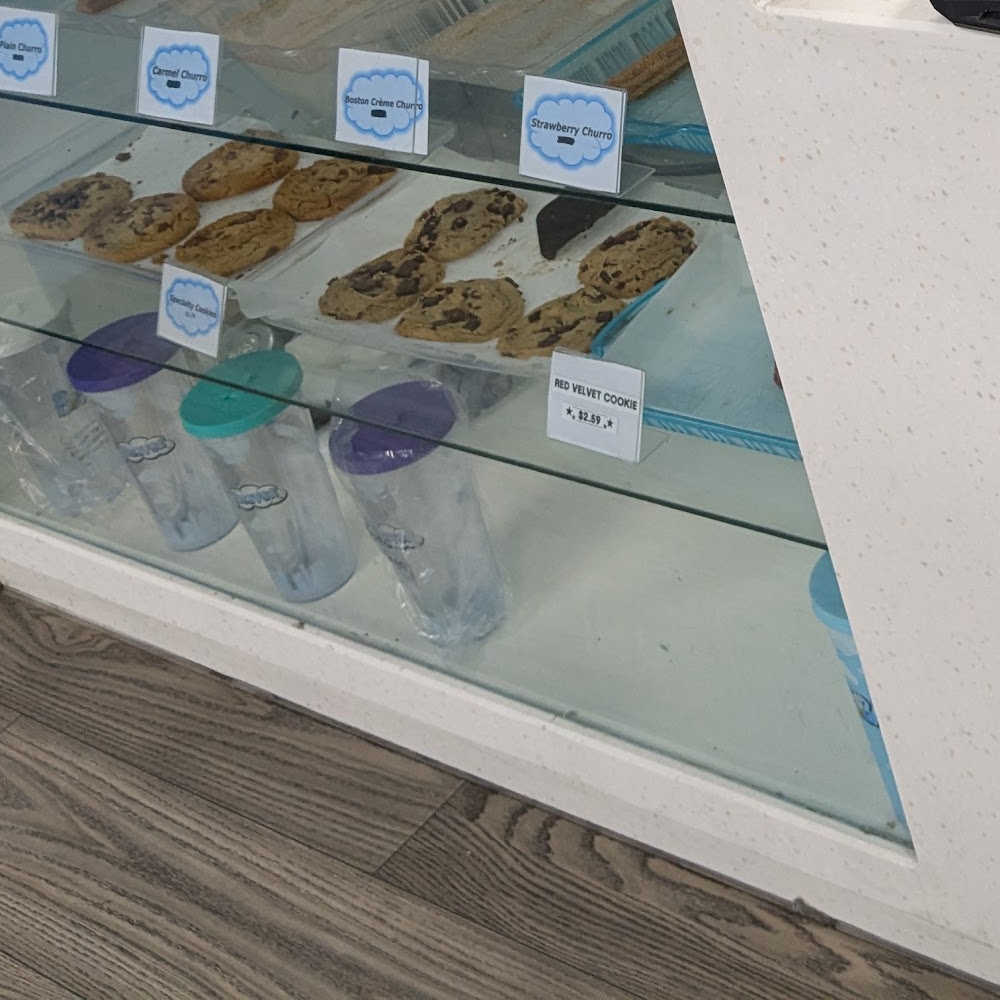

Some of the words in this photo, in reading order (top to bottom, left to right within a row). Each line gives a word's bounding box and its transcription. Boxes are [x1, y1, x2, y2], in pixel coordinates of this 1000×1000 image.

[0, 40, 17, 51] Plain
[18, 42, 43, 54] Churro
[152, 66, 180, 79] Carmel
[181, 70, 208, 83] Churro
[345, 95, 369, 107] Boston
[371, 96, 395, 109] Crème
[396, 99, 424, 111] Churro
[531, 117, 580, 137] Strawberry
[581, 126, 613, 141] Churro
[169, 294, 195, 311] Specialty
[195, 304, 217, 319] Cookies
[554, 378, 570, 391] RED
[572, 382, 602, 401] VELVET
[603, 392, 638, 411] COOKIE
[578, 410, 602, 426] $2.59
